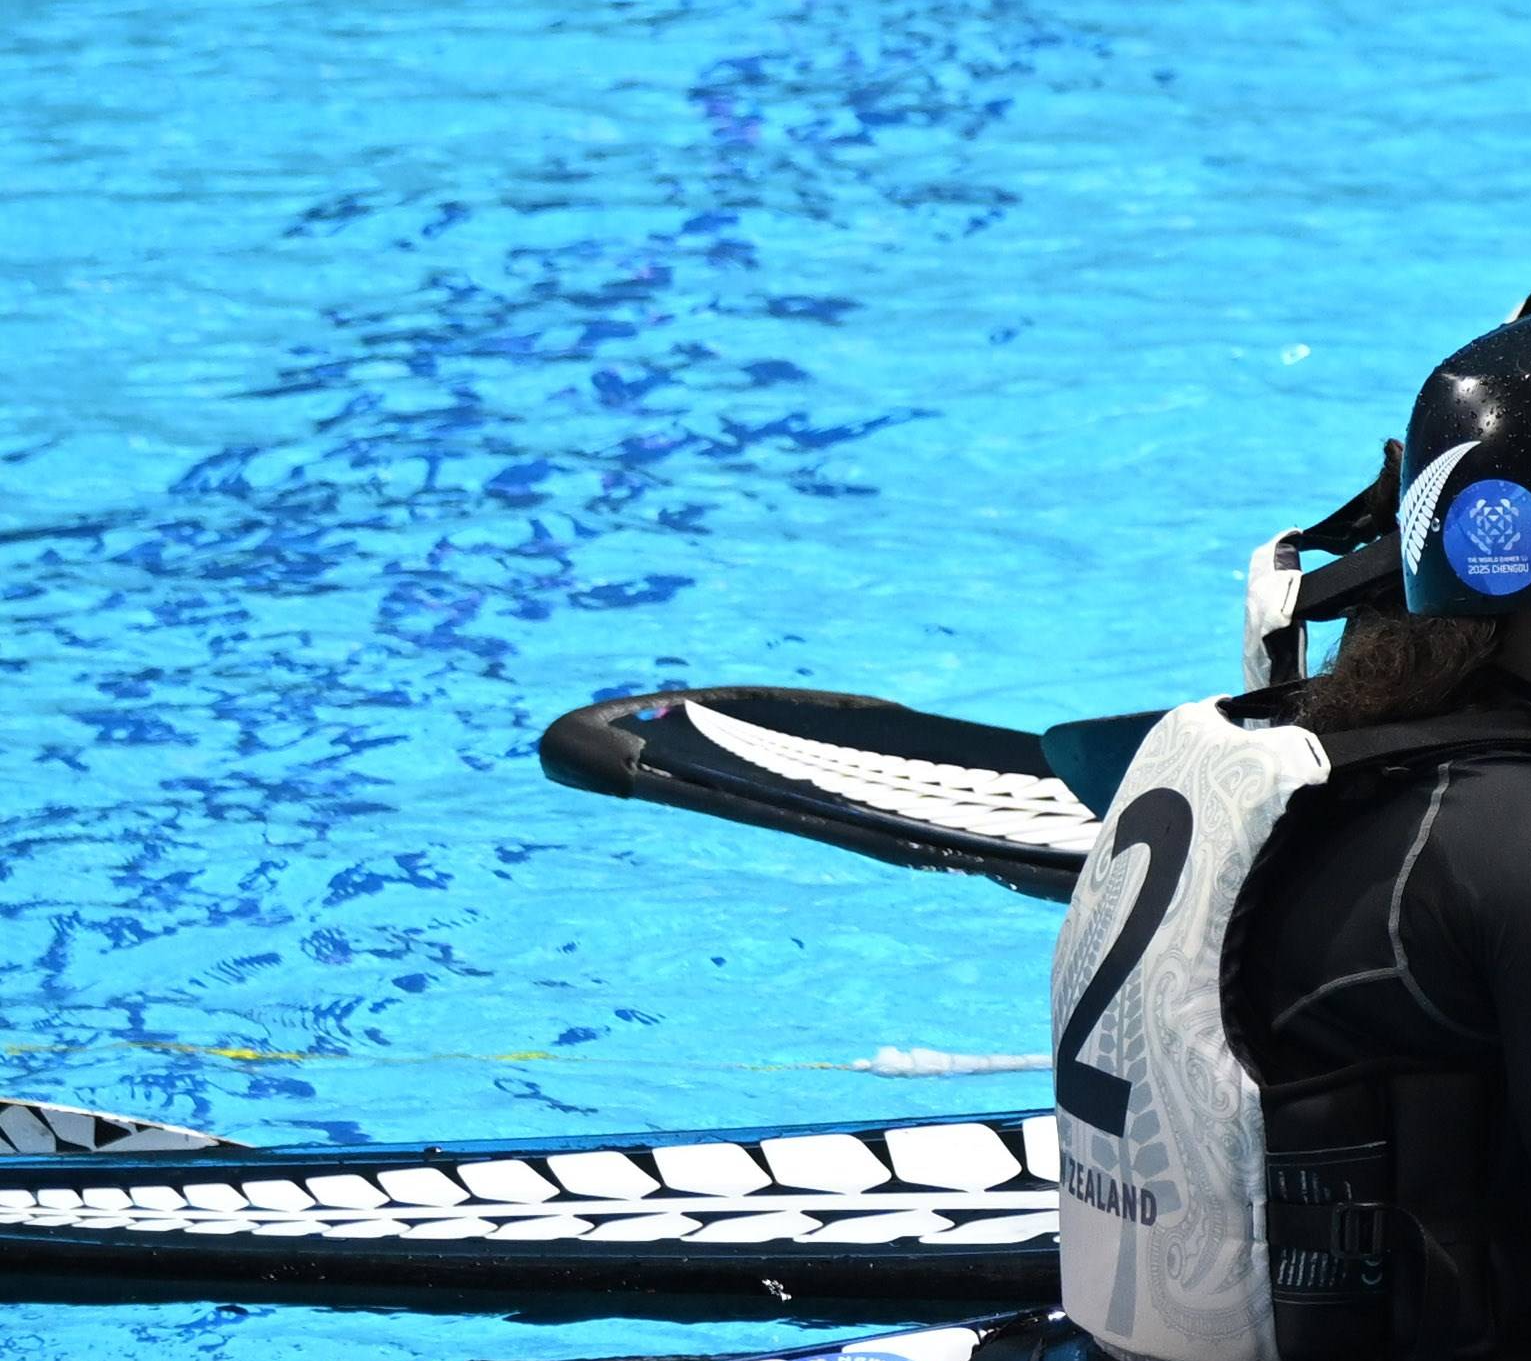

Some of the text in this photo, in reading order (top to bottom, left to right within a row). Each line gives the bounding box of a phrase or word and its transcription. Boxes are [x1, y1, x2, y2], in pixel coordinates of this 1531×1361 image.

[1468, 565, 1491, 575] 2025
[1056, 787, 1194, 1138] 2
[1068, 1156, 1158, 1227] ZEALAND
